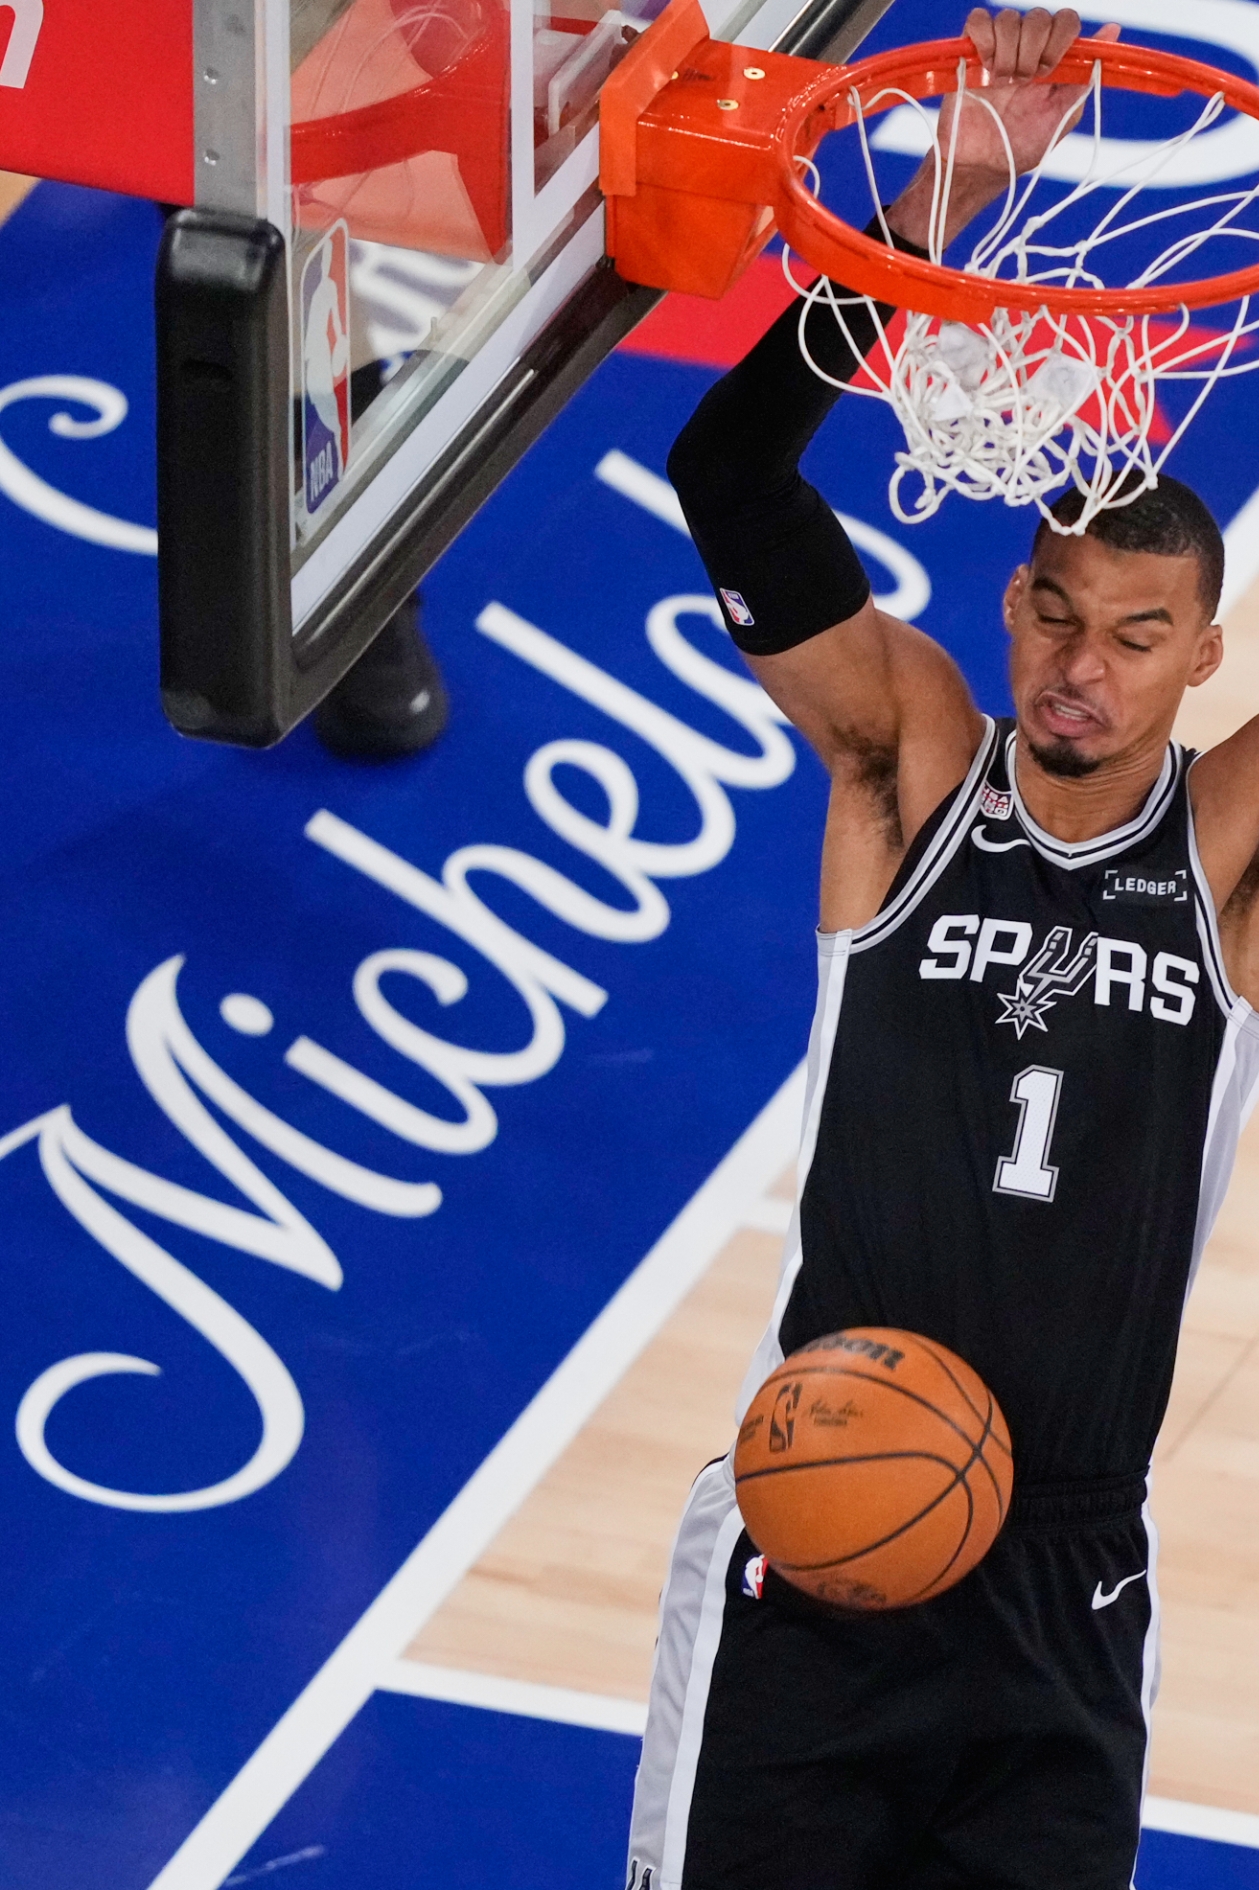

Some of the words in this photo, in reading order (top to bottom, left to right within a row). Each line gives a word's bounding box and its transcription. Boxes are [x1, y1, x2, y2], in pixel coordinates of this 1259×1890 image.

[310, 441, 334, 502] NBA
[1114, 878, 1176, 895] LEDGER
[919, 914, 1200, 1040] SPURS
[992, 1064, 1064, 1202] 1
